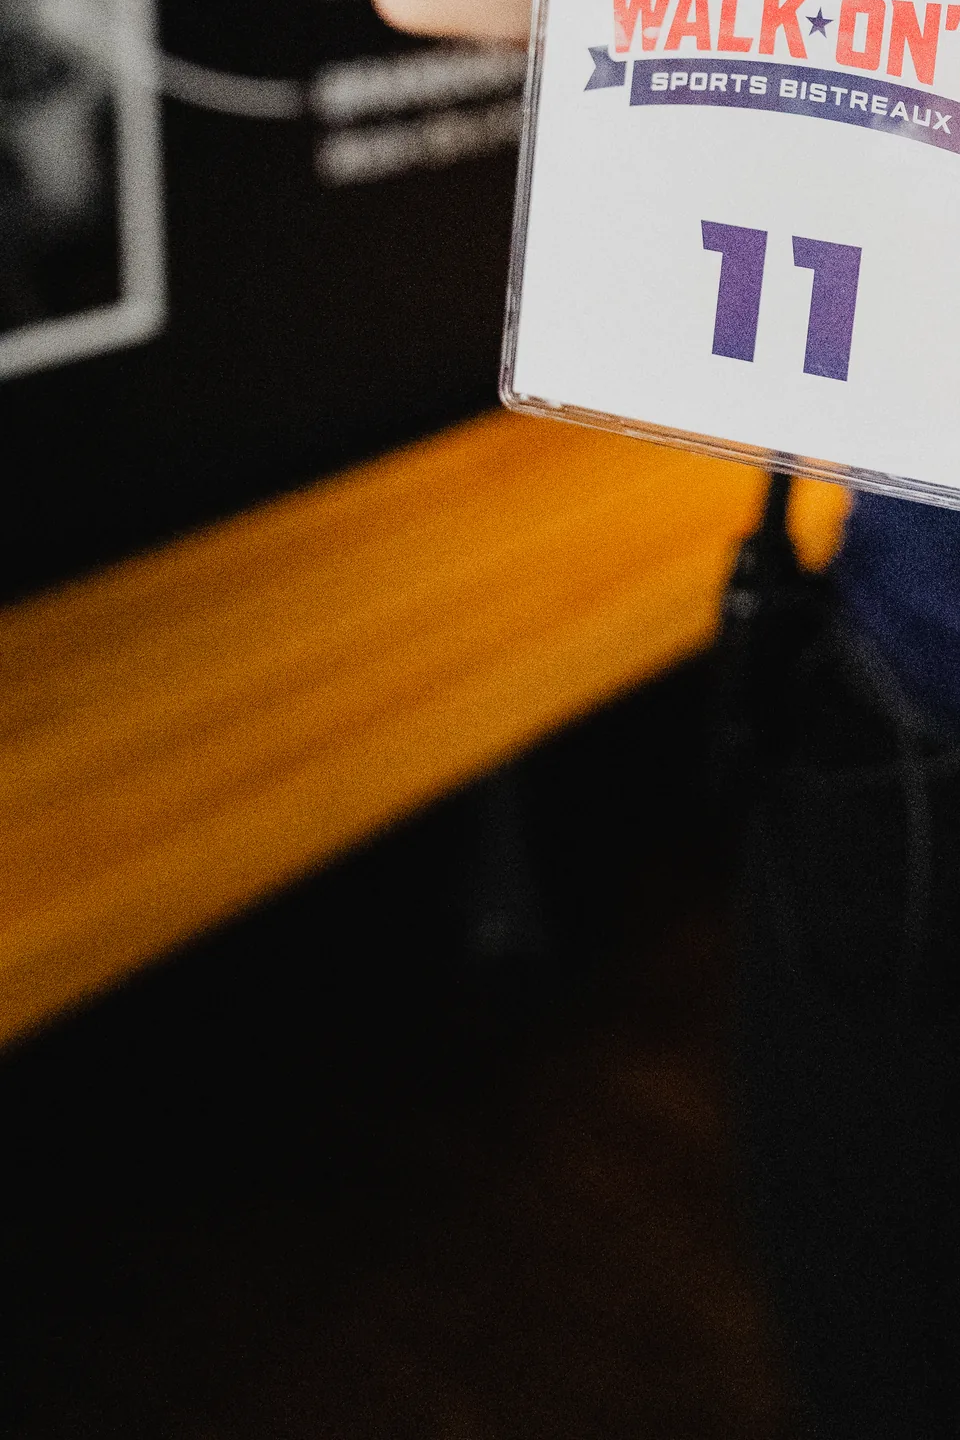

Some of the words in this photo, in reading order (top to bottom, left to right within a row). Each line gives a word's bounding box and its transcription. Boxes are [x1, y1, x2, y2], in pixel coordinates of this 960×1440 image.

[650, 71, 768, 95] SPORTS
[779, 78, 952, 135] BISTREAUX
[700, 219, 862, 381] 11
